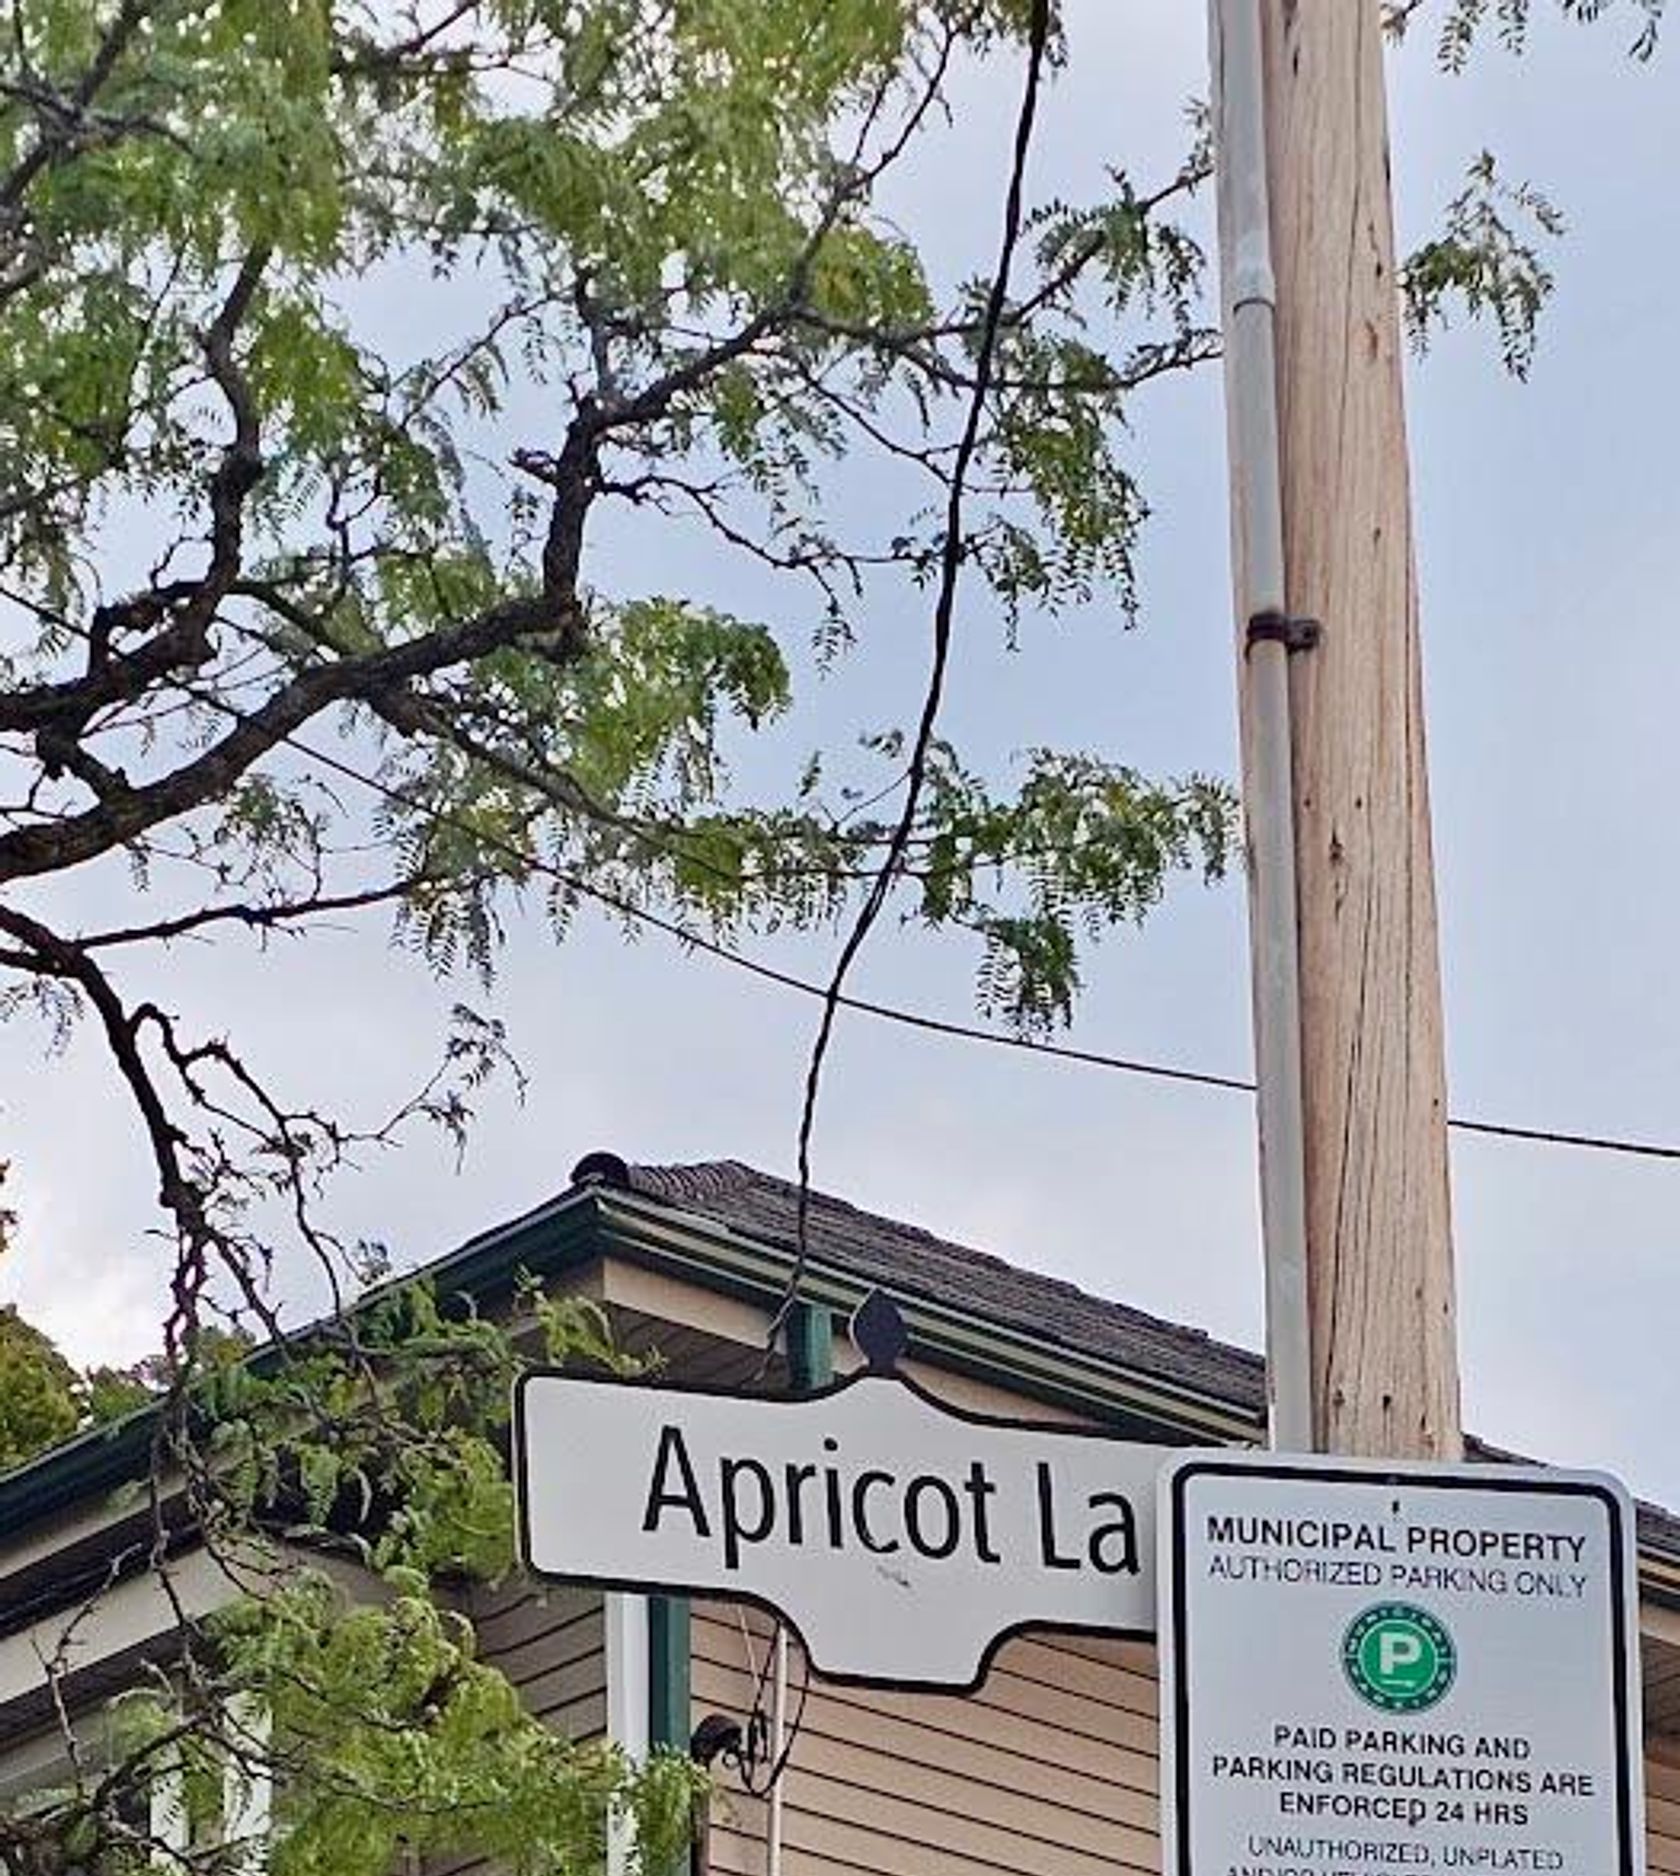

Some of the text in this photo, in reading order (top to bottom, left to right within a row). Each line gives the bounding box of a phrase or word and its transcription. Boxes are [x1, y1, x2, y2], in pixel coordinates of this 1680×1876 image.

[641, 1424, 1001, 1570] Apricot
[1207, 1516, 1586, 1563] MUNICIPAL PROPERTY
[1208, 1556, 1587, 1599] AUTHORIZED PARKING ONLY
[1274, 1726, 1531, 1759] PAID PARKING AND
[1212, 1757, 1595, 1797] PARKING REGULATIONS ARE
[1279, 1793, 1529, 1826] ENFORCED 24 HRS
[1247, 1835, 1564, 1871] UNAUTHORIZED, UNPLATED
